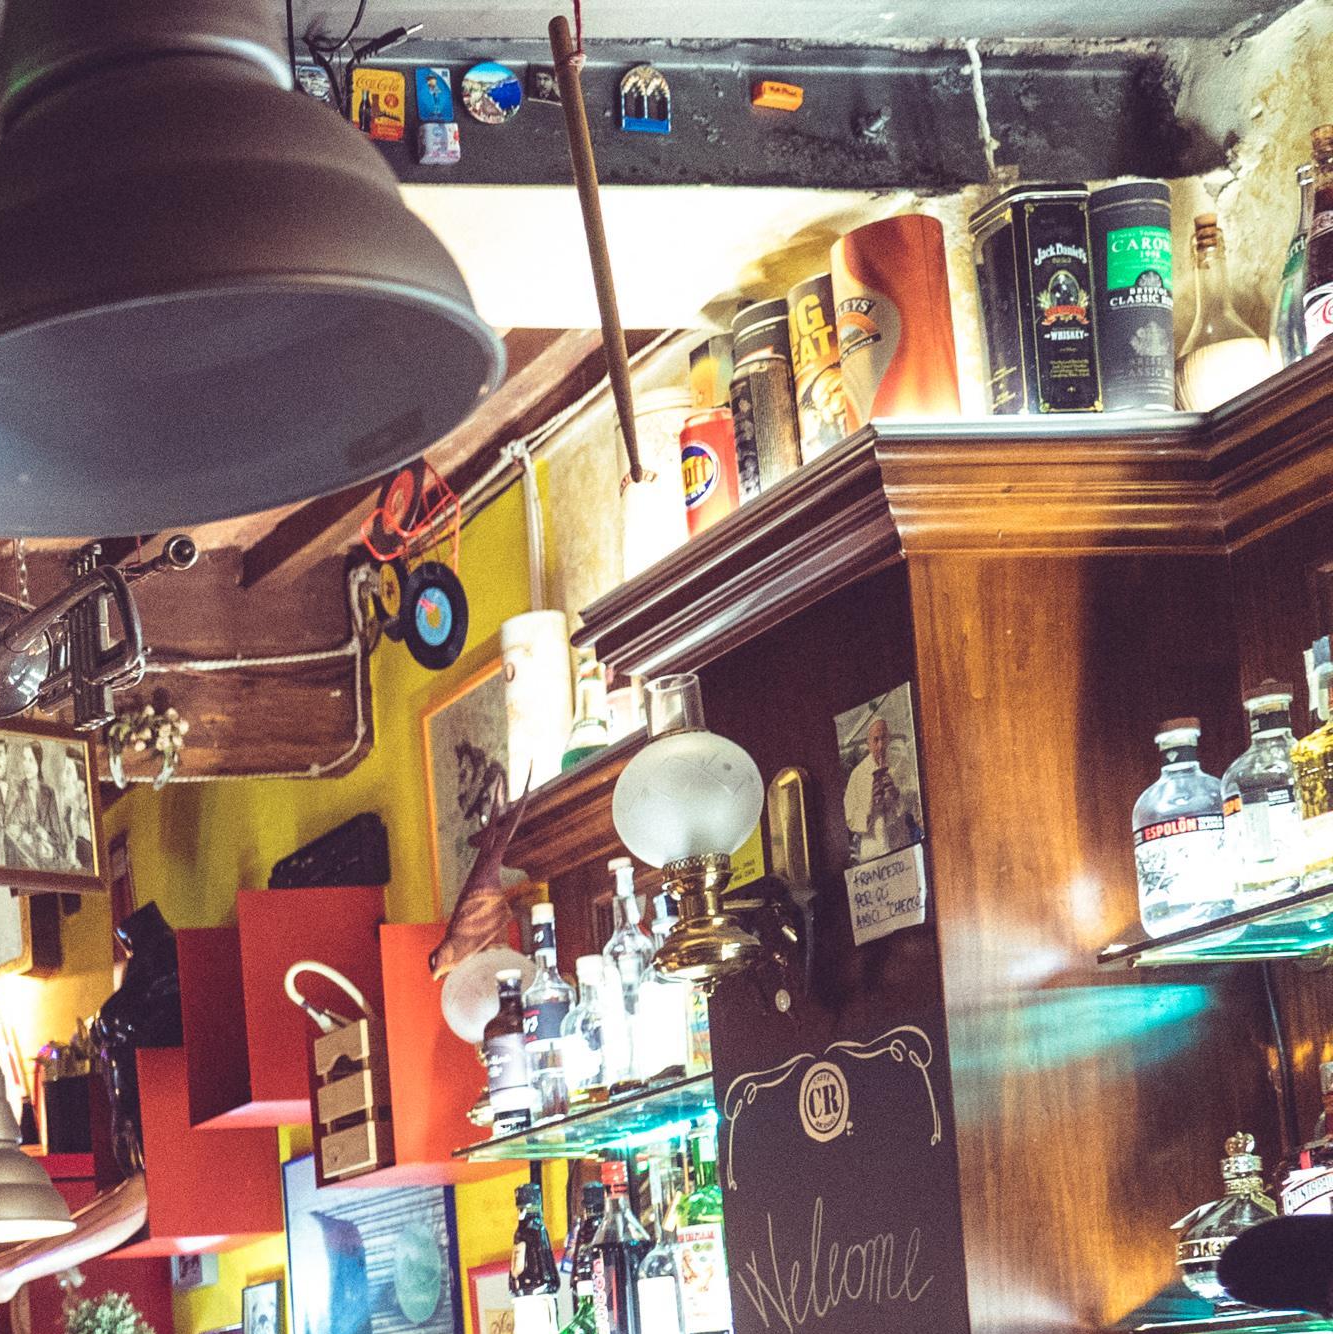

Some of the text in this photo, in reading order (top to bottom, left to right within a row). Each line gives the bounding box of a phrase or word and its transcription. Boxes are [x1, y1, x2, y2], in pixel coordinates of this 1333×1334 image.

[1110, 294, 1160, 307] CLASSIC
[1050, 329, 1085, 341] WHISKEY
[809, 1083, 840, 1119] CR
[737, 1197, 933, 1334] Welcome
